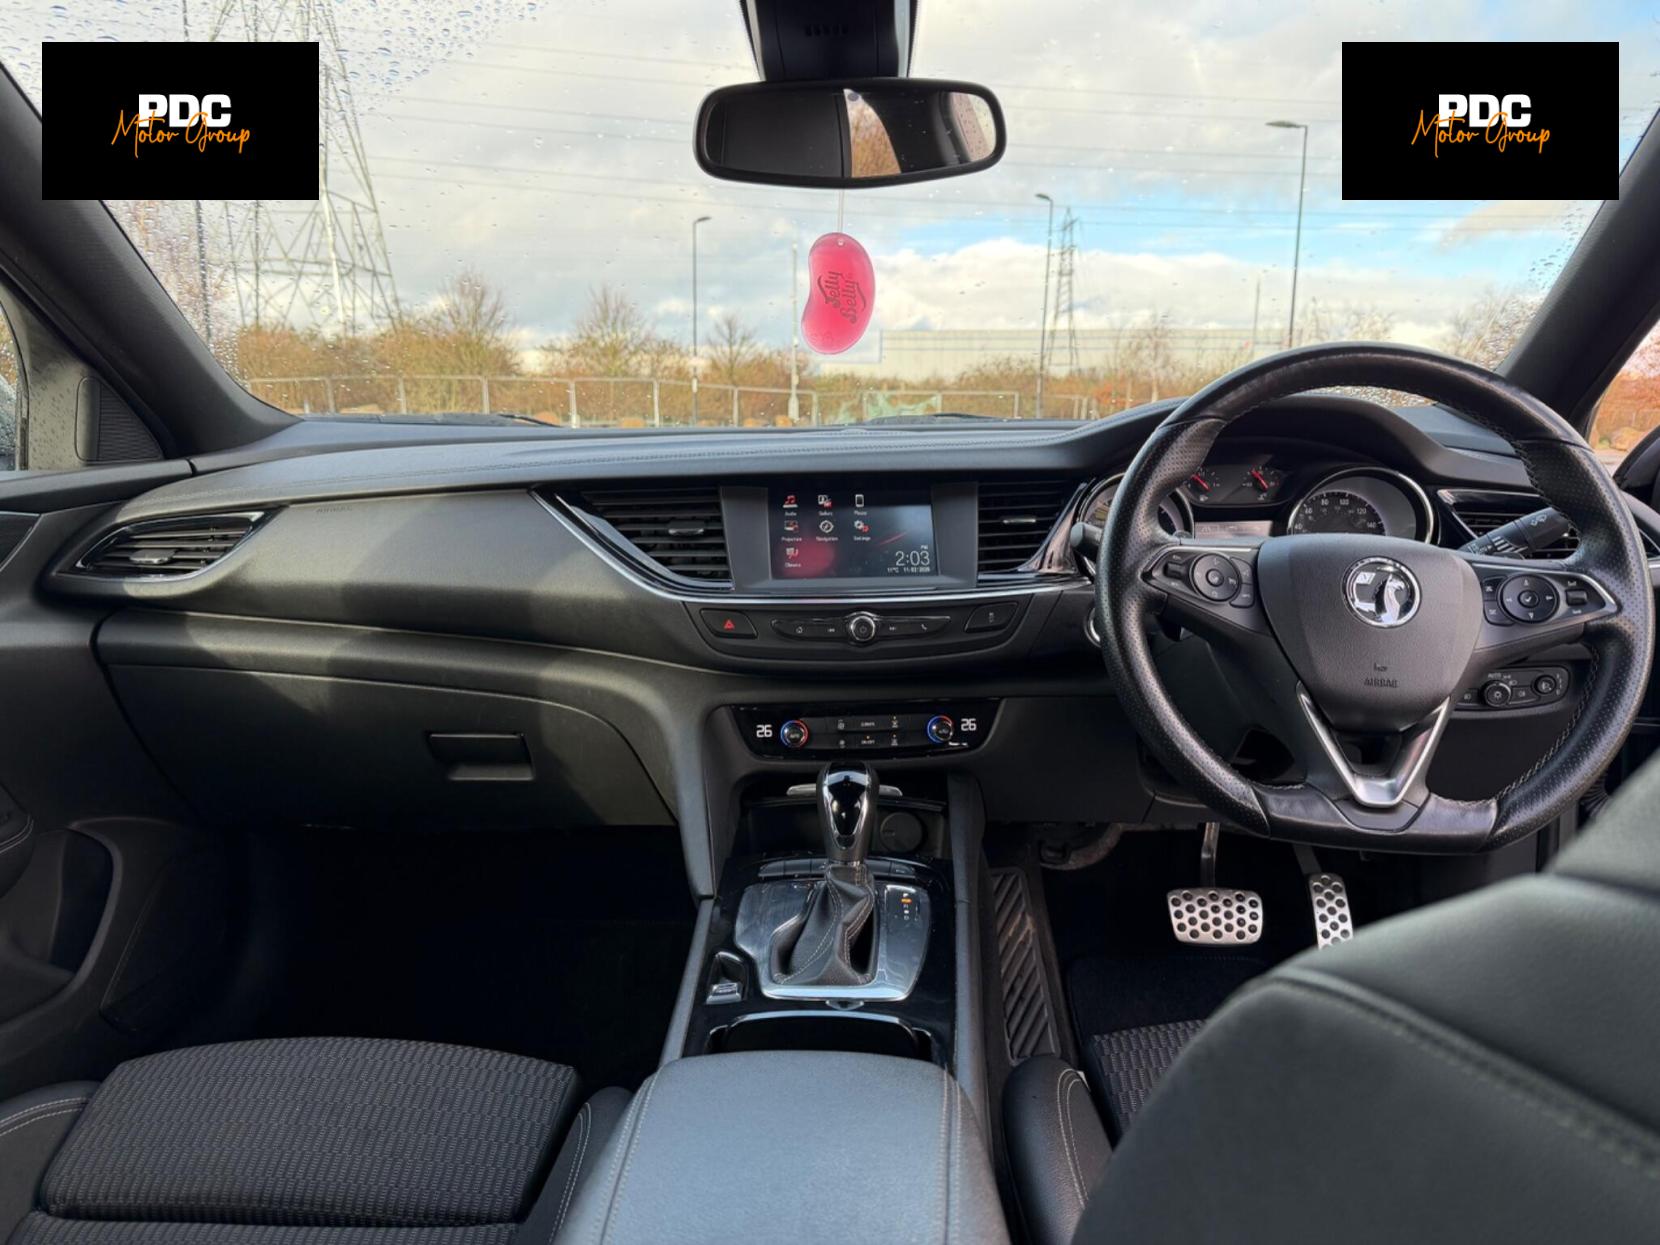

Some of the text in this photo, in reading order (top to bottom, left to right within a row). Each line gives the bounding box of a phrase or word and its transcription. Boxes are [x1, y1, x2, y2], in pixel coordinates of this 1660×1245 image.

[895, 550, 930, 566] 2:03
[756, 724, 773, 738] 26
[961, 718, 977, 731] 26
